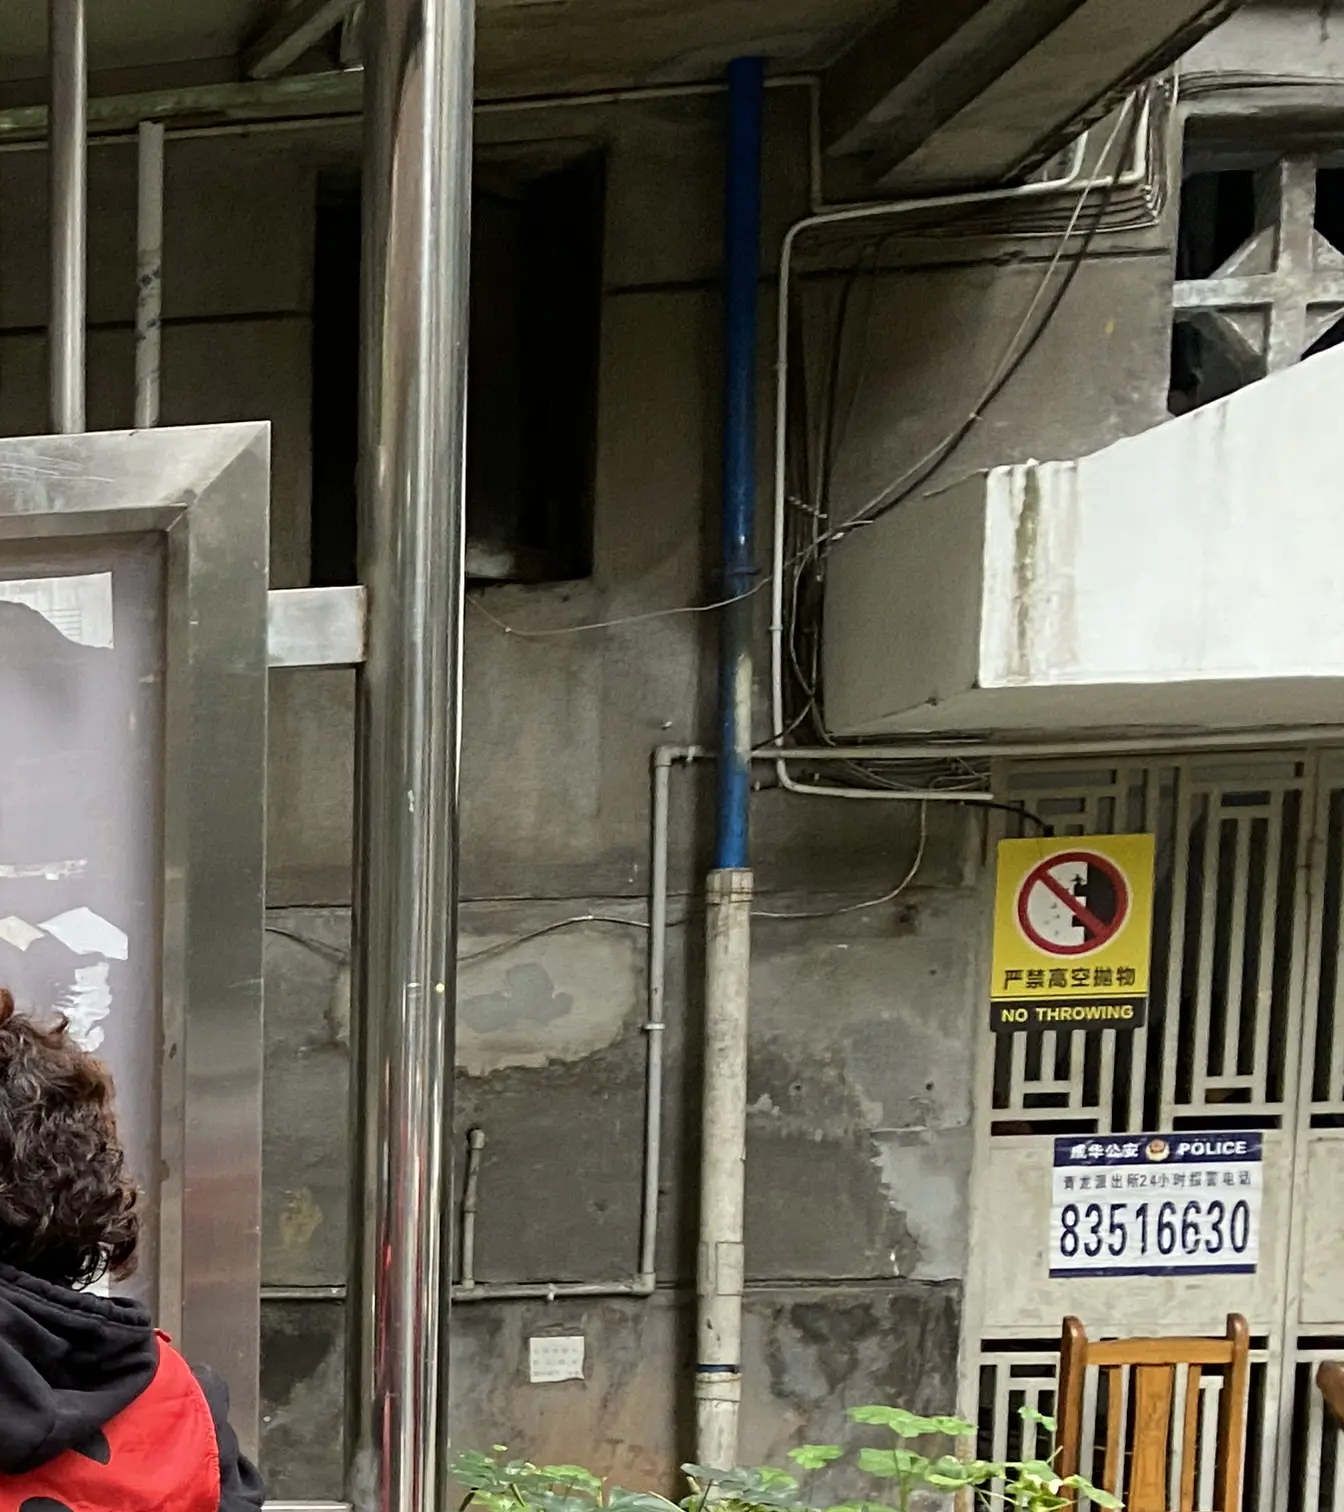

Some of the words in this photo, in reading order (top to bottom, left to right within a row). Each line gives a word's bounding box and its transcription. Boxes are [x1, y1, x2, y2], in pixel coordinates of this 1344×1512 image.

[1004, 966, 1137, 991] 严禁高空抛物
[1001, 1008, 1029, 1024] NO
[1036, 1005, 1135, 1022] THROWING
[1069, 1142, 1140, 1160] 成华公安
[1175, 1141, 1248, 1156] POLICE
[1060, 1199, 1251, 1258] 83516630
